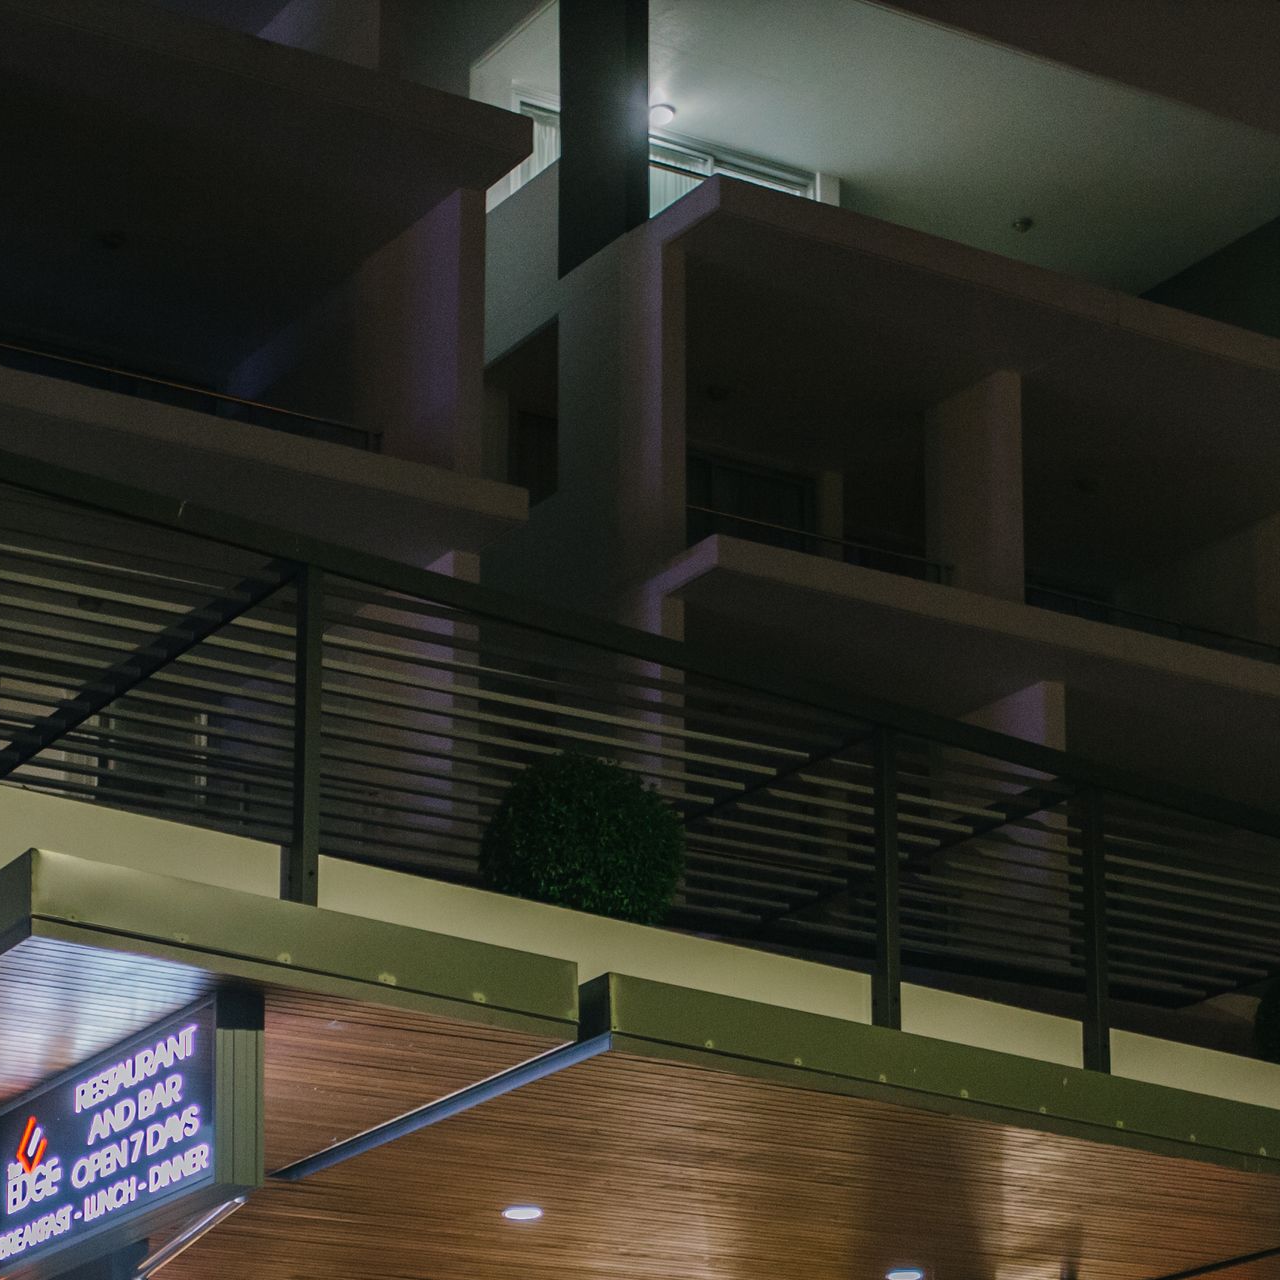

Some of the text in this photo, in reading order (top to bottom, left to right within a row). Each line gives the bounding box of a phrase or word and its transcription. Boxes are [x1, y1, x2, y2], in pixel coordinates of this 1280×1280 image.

[76, 1024, 198, 1113] RESTAURANT
[71, 1106, 200, 1188] OPEN 7 DAYS
[87, 1073, 183, 1145] AND BAR
[7, 1158, 62, 1215] EDGE
[83, 1177, 137, 1222] LUNCH
[149, 1145, 210, 1193] DINNER
